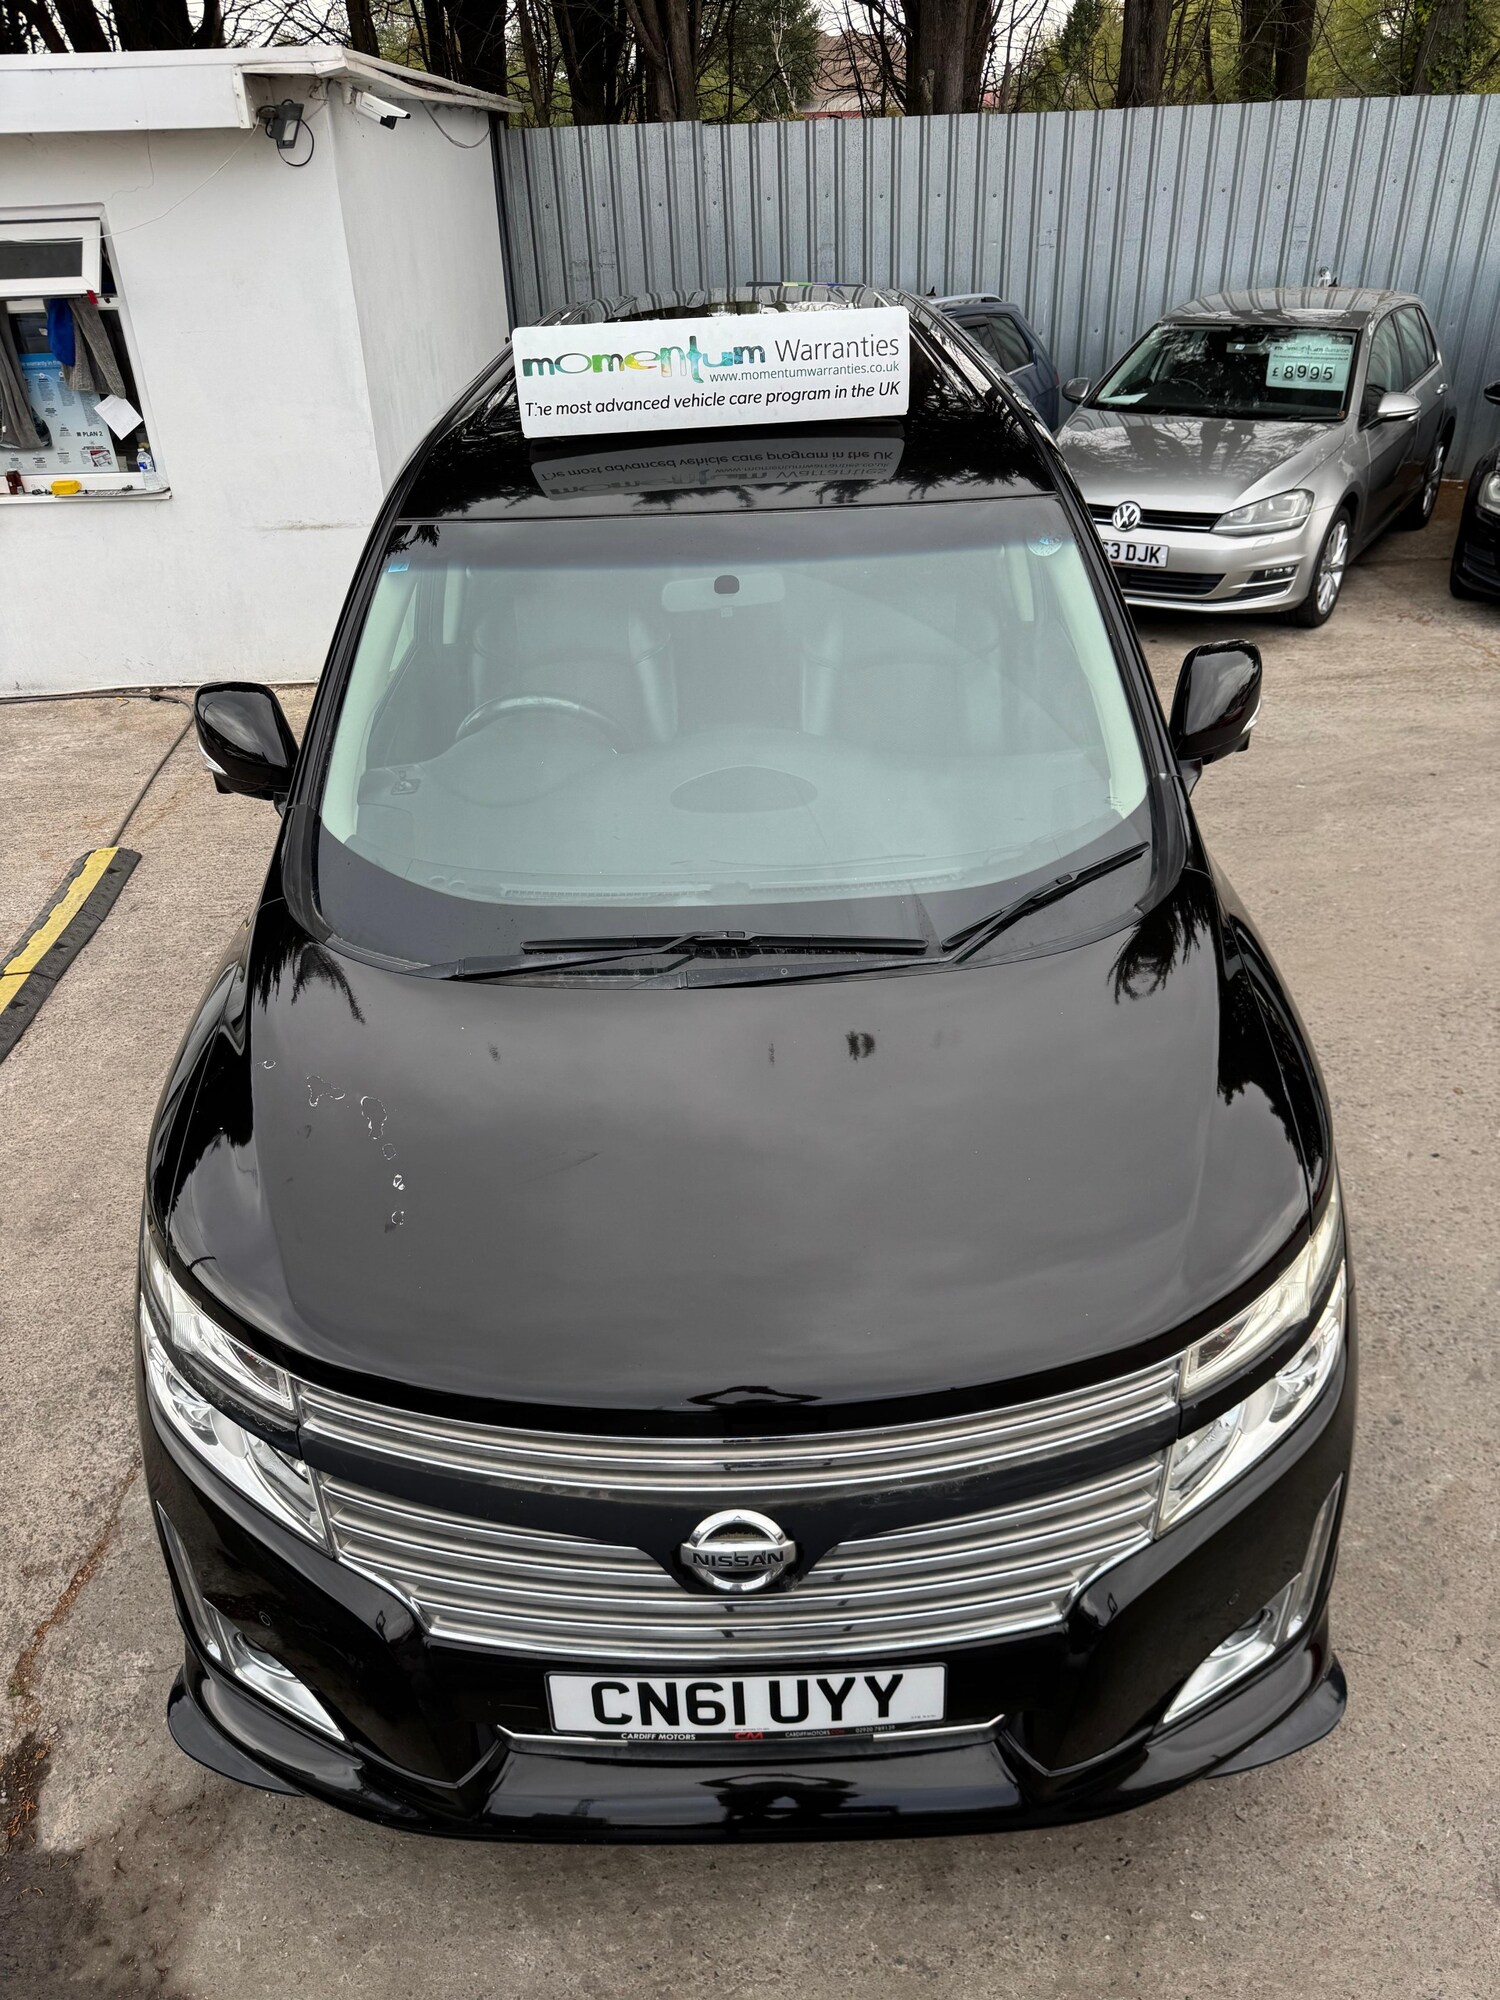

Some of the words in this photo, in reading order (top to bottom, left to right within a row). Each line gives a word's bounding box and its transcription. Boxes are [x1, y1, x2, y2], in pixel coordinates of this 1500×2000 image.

[522, 335, 766, 384] momentum
[775, 334, 899, 363] Warranties
[709, 361, 900, 383] www.momentumwarranties.co.uk
[556, 402, 592, 416] most
[595, 394, 670, 413] advanced
[674, 391, 725, 409] vehicle
[729, 392, 762, 406] care
[766, 386, 831, 407] program
[834, 384, 848, 399] in
[851, 383, 875, 398] the
[878, 381, 901, 397] UK
[1125, 544, 1161, 564] DJK
[692, 1550, 784, 1567] NISSAN
[591, 1681, 746, 1726] CN61
[768, 1674, 904, 1724] UYY
[621, 1732, 657, 1741] CARDIFF
[658, 1733, 696, 1741] MOTORS
